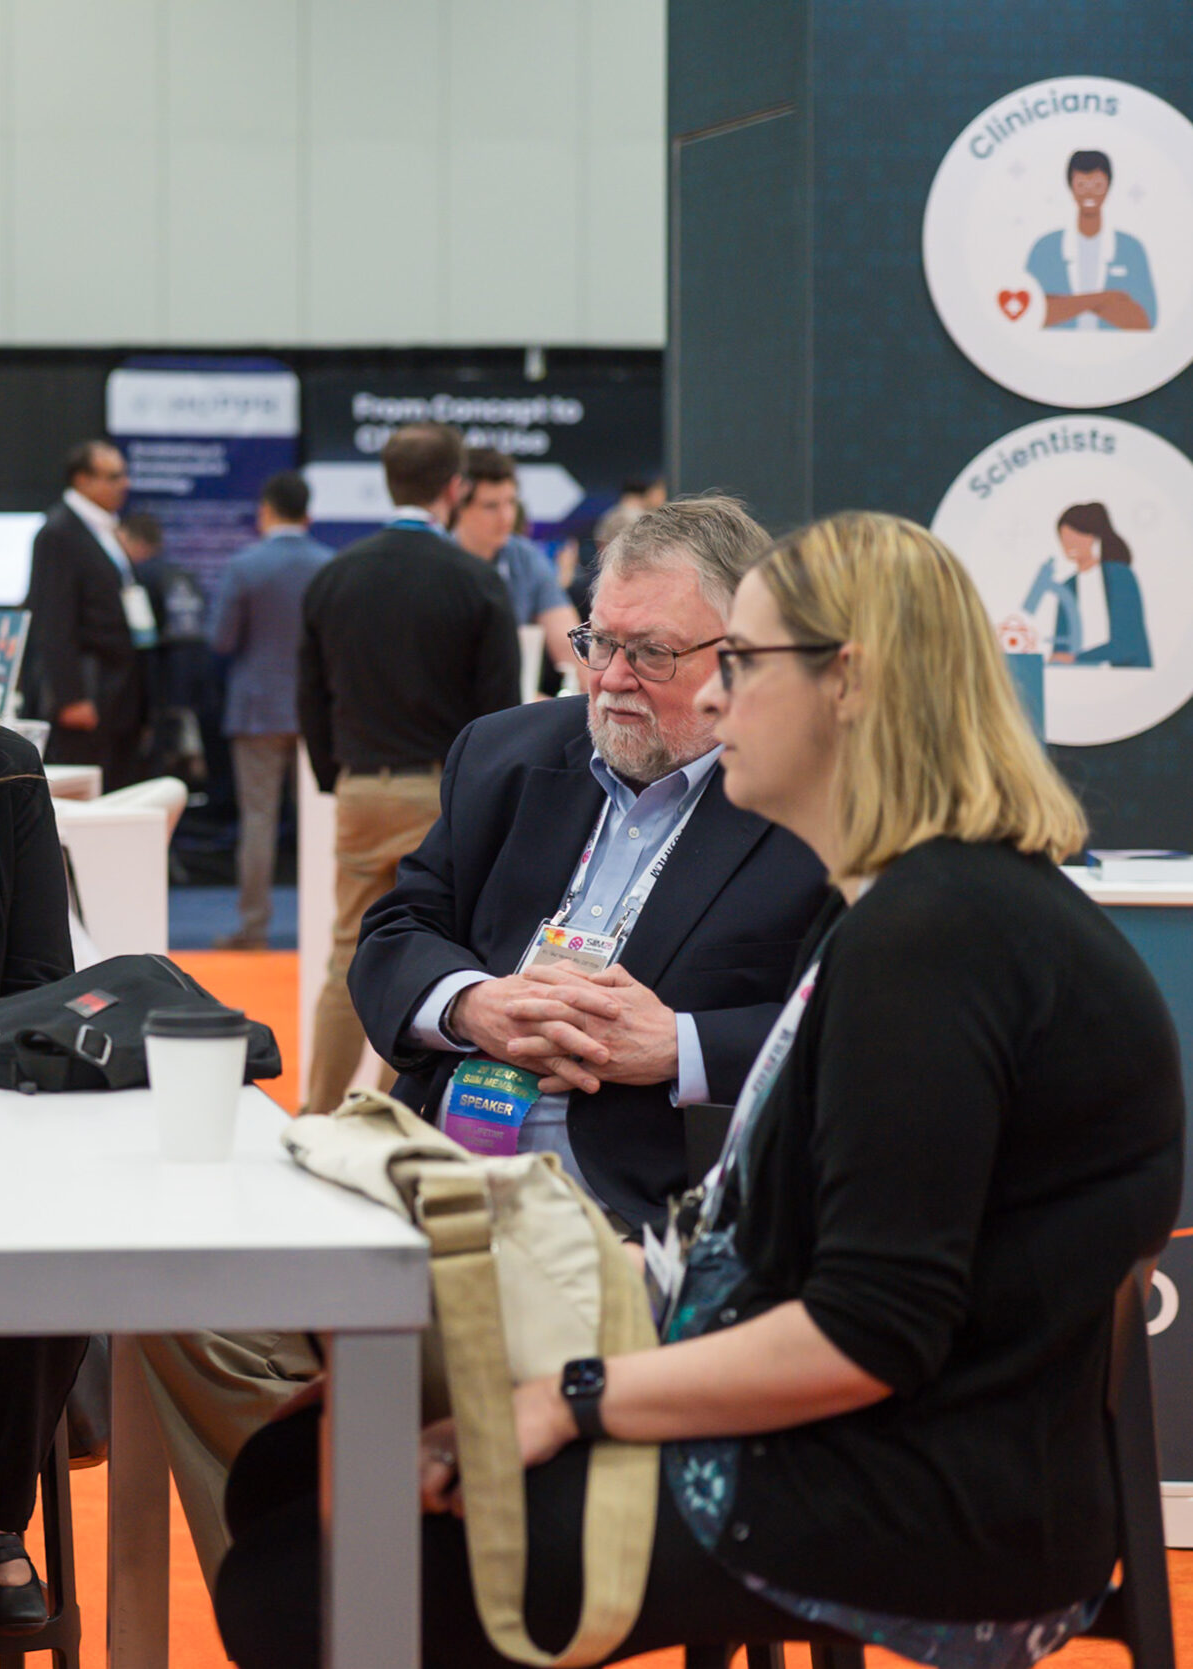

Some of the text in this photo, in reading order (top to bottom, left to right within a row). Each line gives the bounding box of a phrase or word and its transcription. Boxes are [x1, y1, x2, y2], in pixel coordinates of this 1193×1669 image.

[969, 87, 1120, 161] Clinicians
[352, 392, 584, 429] From Concept to
[968, 425, 1118, 500] Scientists
[459, 1093, 514, 1117] SPEAKER
